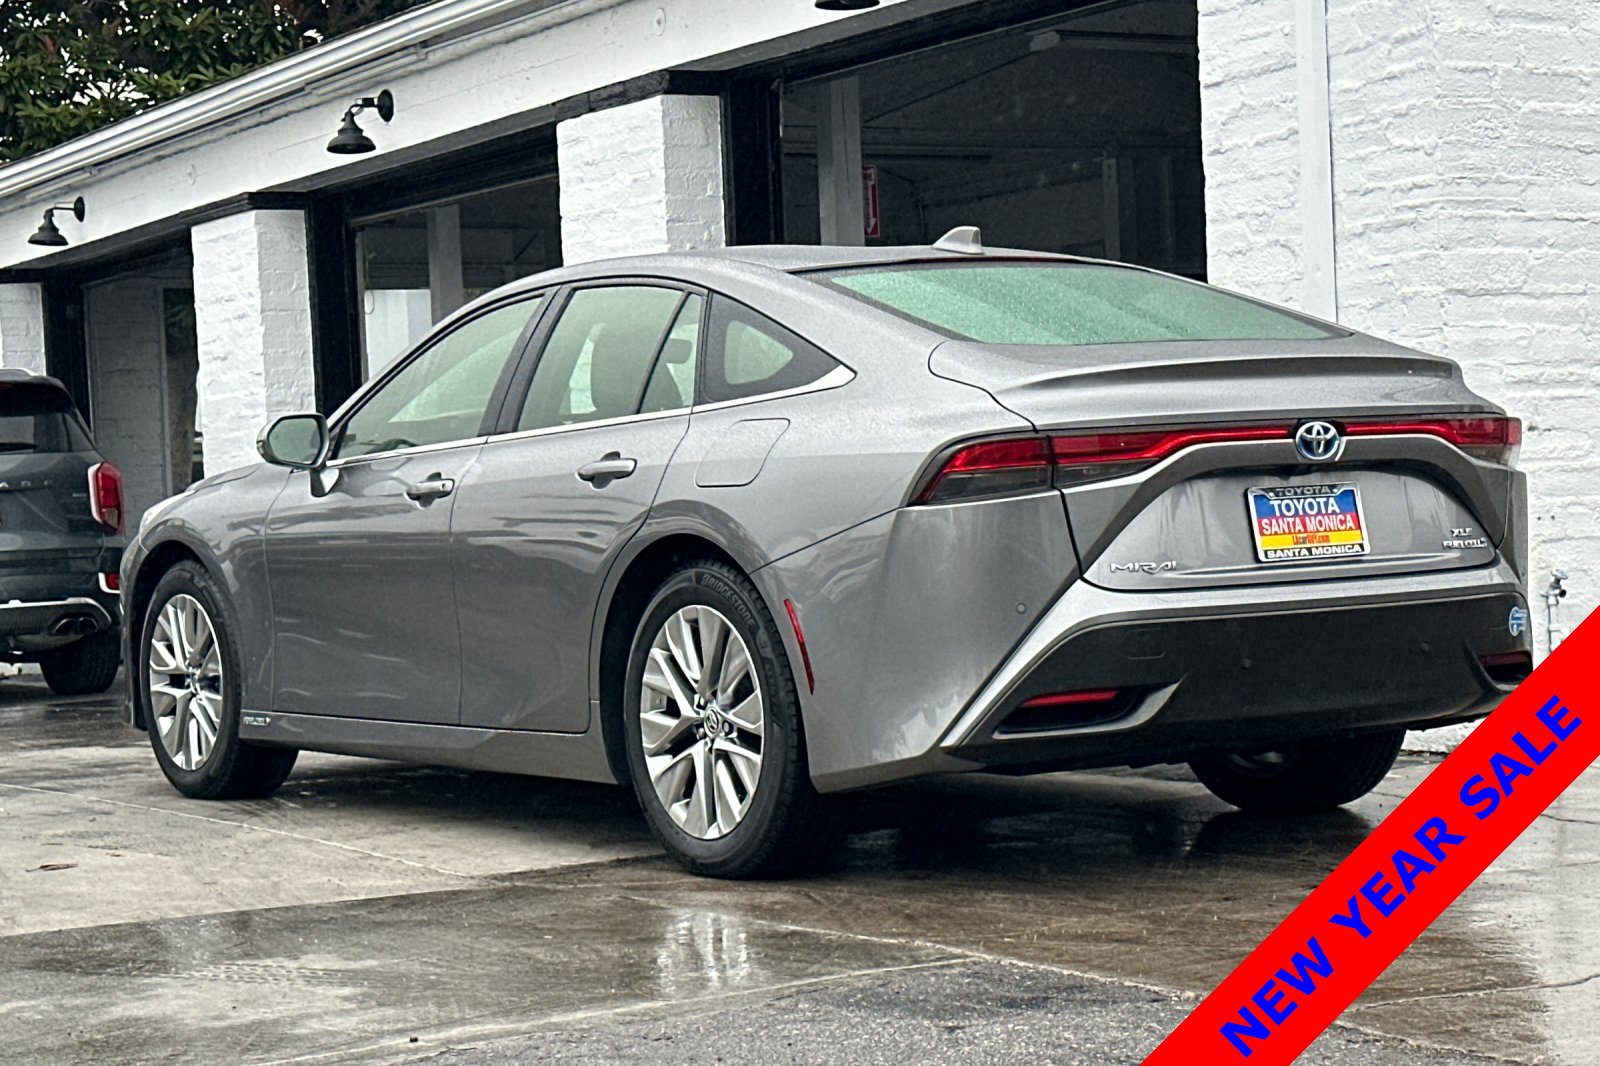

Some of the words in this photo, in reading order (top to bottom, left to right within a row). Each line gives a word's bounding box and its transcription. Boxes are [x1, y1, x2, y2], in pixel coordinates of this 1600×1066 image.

[1275, 486, 1331, 496] TOYOTA
[1269, 497, 1341, 517] TOYOTA
[1261, 517, 1304, 535] SANTA
[1305, 513, 1356, 532] MONICA
[1266, 547, 1309, 559] SANTA
[1311, 543, 1362, 556] MONICA
